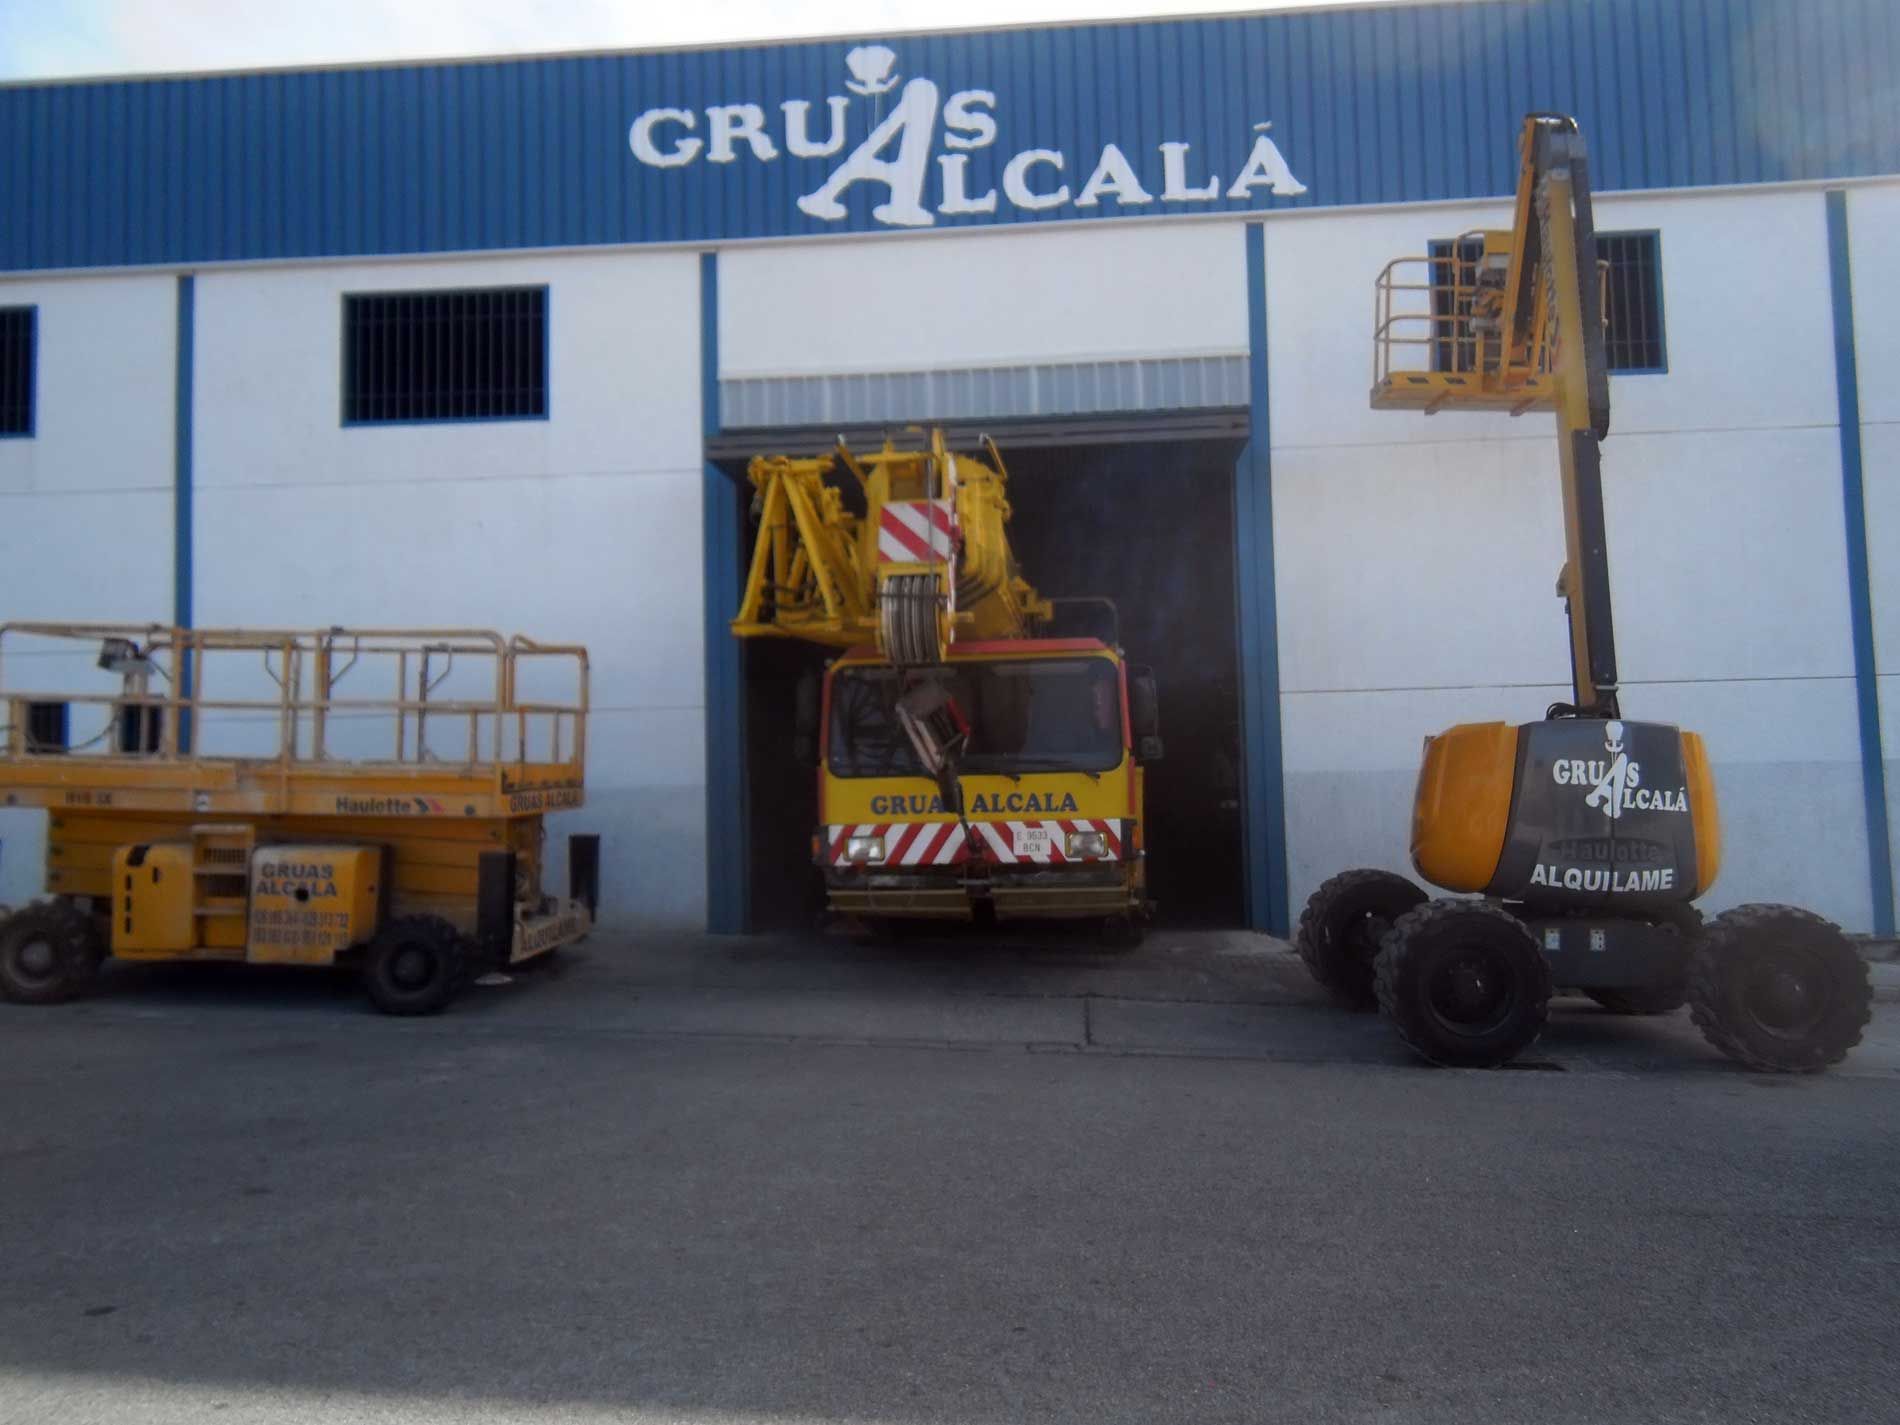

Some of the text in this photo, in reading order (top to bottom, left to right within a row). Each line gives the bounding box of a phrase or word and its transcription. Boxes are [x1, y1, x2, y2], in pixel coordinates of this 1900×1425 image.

[336, 796, 411, 813] Haulotte
[971, 792, 1078, 813] ALCALA
[261, 863, 334, 879] GRUAS
[1529, 863, 1674, 893] ALQUILAME
